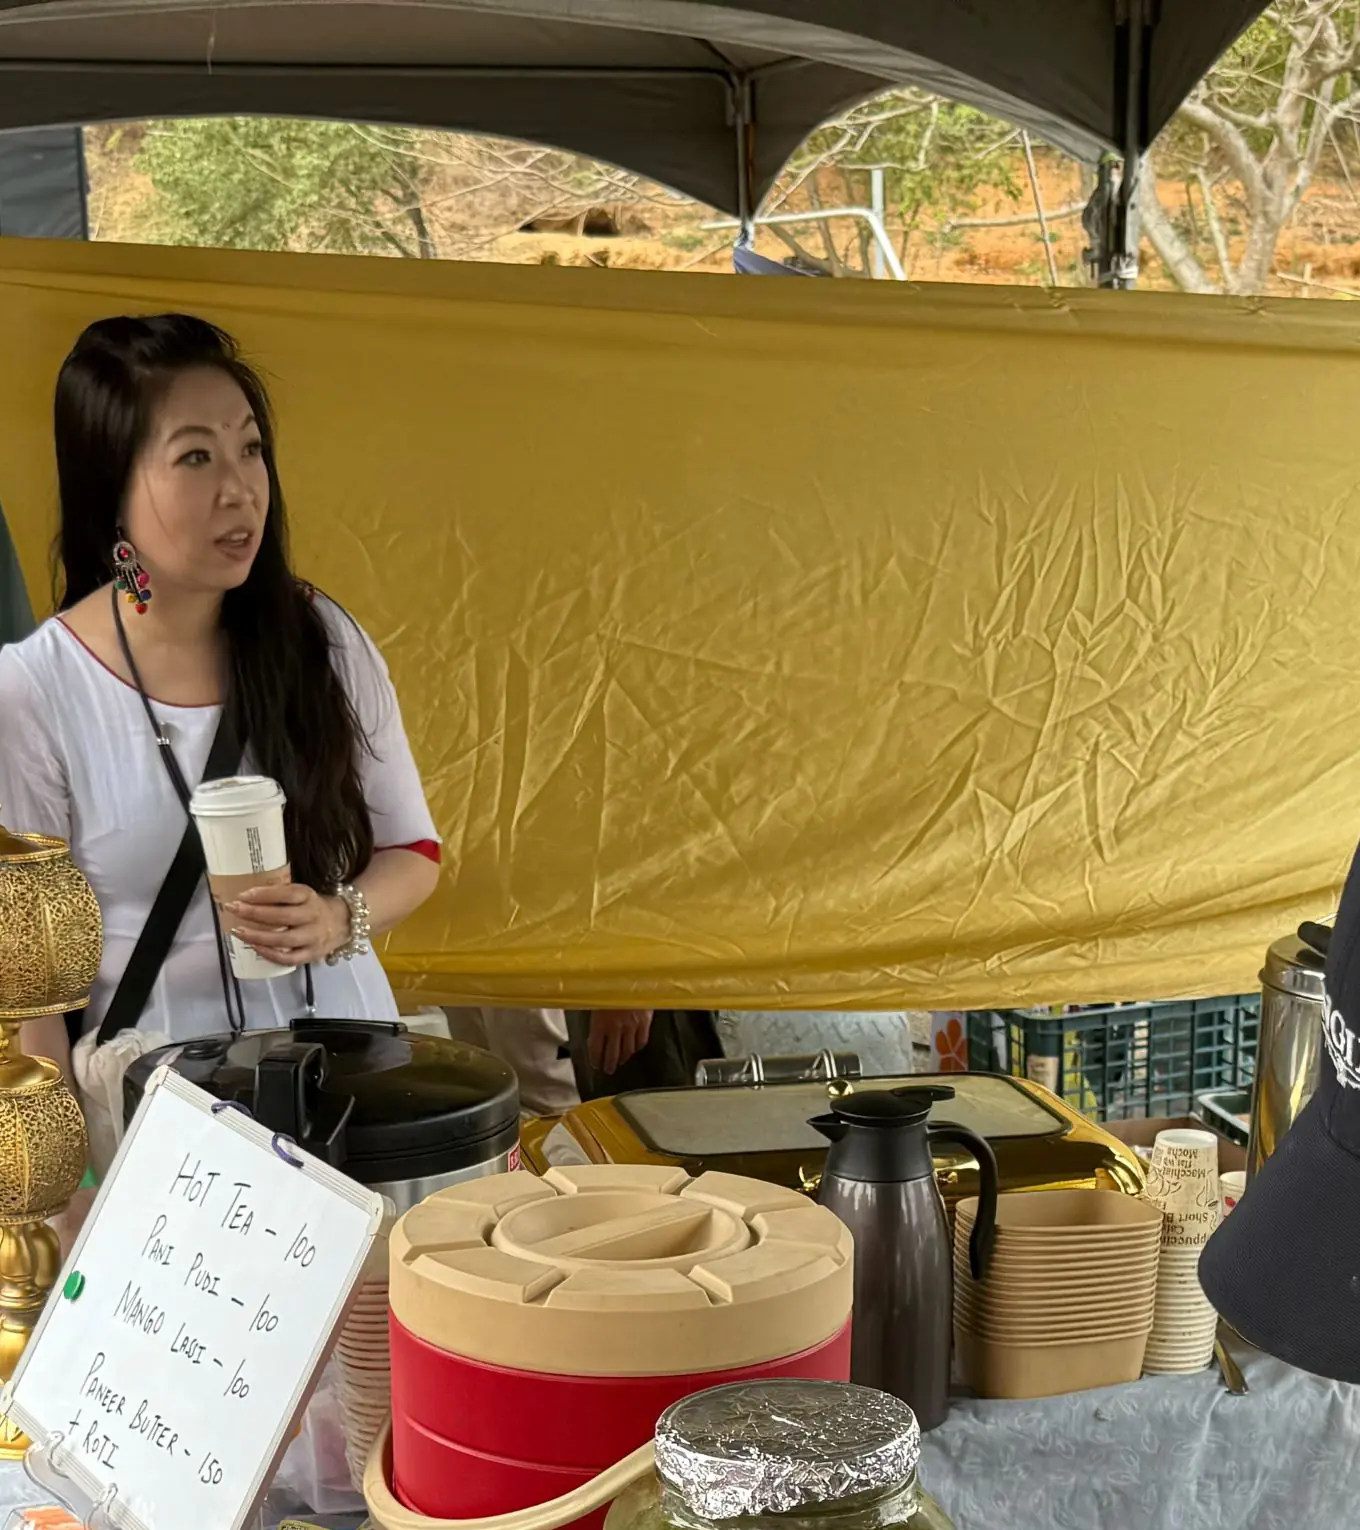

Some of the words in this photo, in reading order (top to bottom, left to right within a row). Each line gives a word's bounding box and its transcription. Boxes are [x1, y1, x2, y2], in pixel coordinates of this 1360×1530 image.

[169, 1152, 221, 1208] HOT
[220, 1182, 254, 1236] TEA
[284, 1222, 317, 1268] 100
[141, 1214, 175, 1266] PANI
[248, 1293, 279, 1332] 100
[113, 1279, 166, 1335] MANGO
[170, 1321, 207, 1364] LASSI
[223, 1358, 250, 1399] 100
[79, 1351, 127, 1416] PANEER
[128, 1398, 179, 1456] BUTTER
[197, 1451, 224, 1485] 150
[82, 1419, 120, 1470] ROTI
